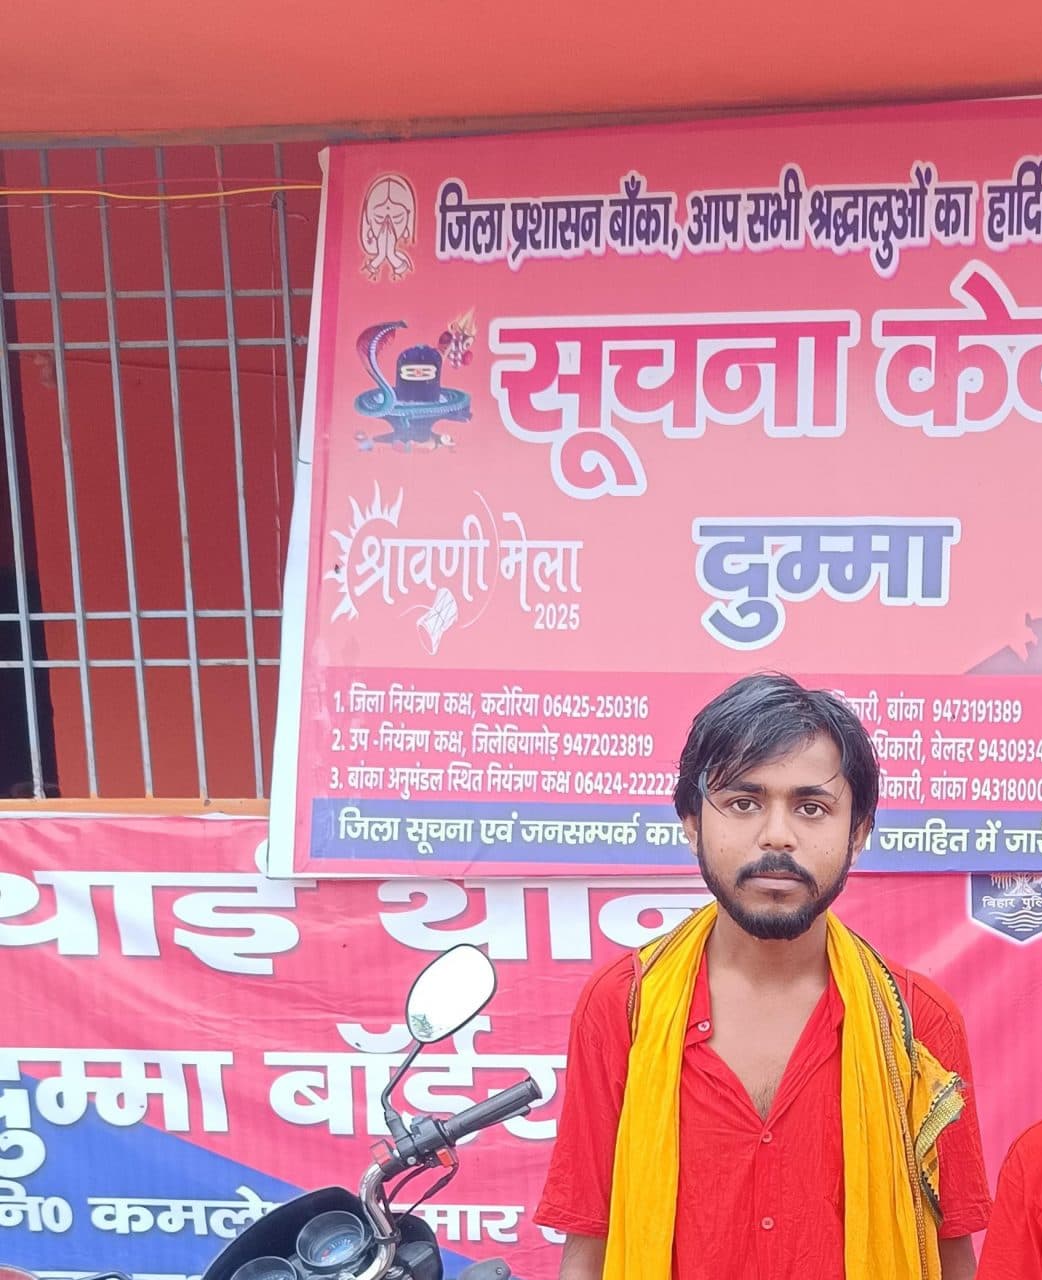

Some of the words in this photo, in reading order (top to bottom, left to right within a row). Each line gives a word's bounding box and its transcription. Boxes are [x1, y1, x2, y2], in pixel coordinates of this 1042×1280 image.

[437, 183, 503, 253] जिला
[509, 198, 602, 260] प्रशासन
[687, 193, 738, 246] आप
[747, 168, 801, 245] सभी
[808, 167, 934, 270] श्रद्धालुओं
[934, 184, 972, 238] का
[494, 314, 856, 493] सूचना
[353, 514, 490, 605] श्रावणी
[500, 511, 584, 612] मेला
[695, 519, 958, 646] दुम्मा
[534, 603, 580, 631] 2025
[333, 690, 345, 714] 1.
[349, 682, 386, 714] जिला
[389, 682, 440, 715] नियंत्रण
[443, 692, 477, 719] कक्ष,
[480, 684, 540, 718] कटोरिया
[543, 694, 649, 719] 06425-250316
[886, 691, 926, 722] बांका
[932, 699, 1022, 723] 9473191389
[332, 728, 346, 751] 2.
[349, 728, 370, 752] उप
[433, 730, 467, 758] कक्ष,
[563, 733, 654, 758] 9472023819
[930, 729, 975, 764] बेलहर
[329, 766, 344, 790] 3.
[347, 759, 385, 790] बांका
[388, 761, 445, 800] अनुमंडल
[447, 761, 484, 792] स्थित
[487, 762, 539, 794] नियंत्रण
[541, 770, 572, 794] कक्ष
[930, 770, 968, 801] बांका
[339, 806, 401, 842] जिला
[406, 818, 474, 854] सूचना
[480, 811, 519, 844] एवं
[520, 811, 641, 846] जनसम्पर्क
[878, 817, 970, 856] जनहित
[975, 818, 1003, 854] में
[982, 895, 1016, 909] बिहार
[87, 1186, 286, 1239] कमले
